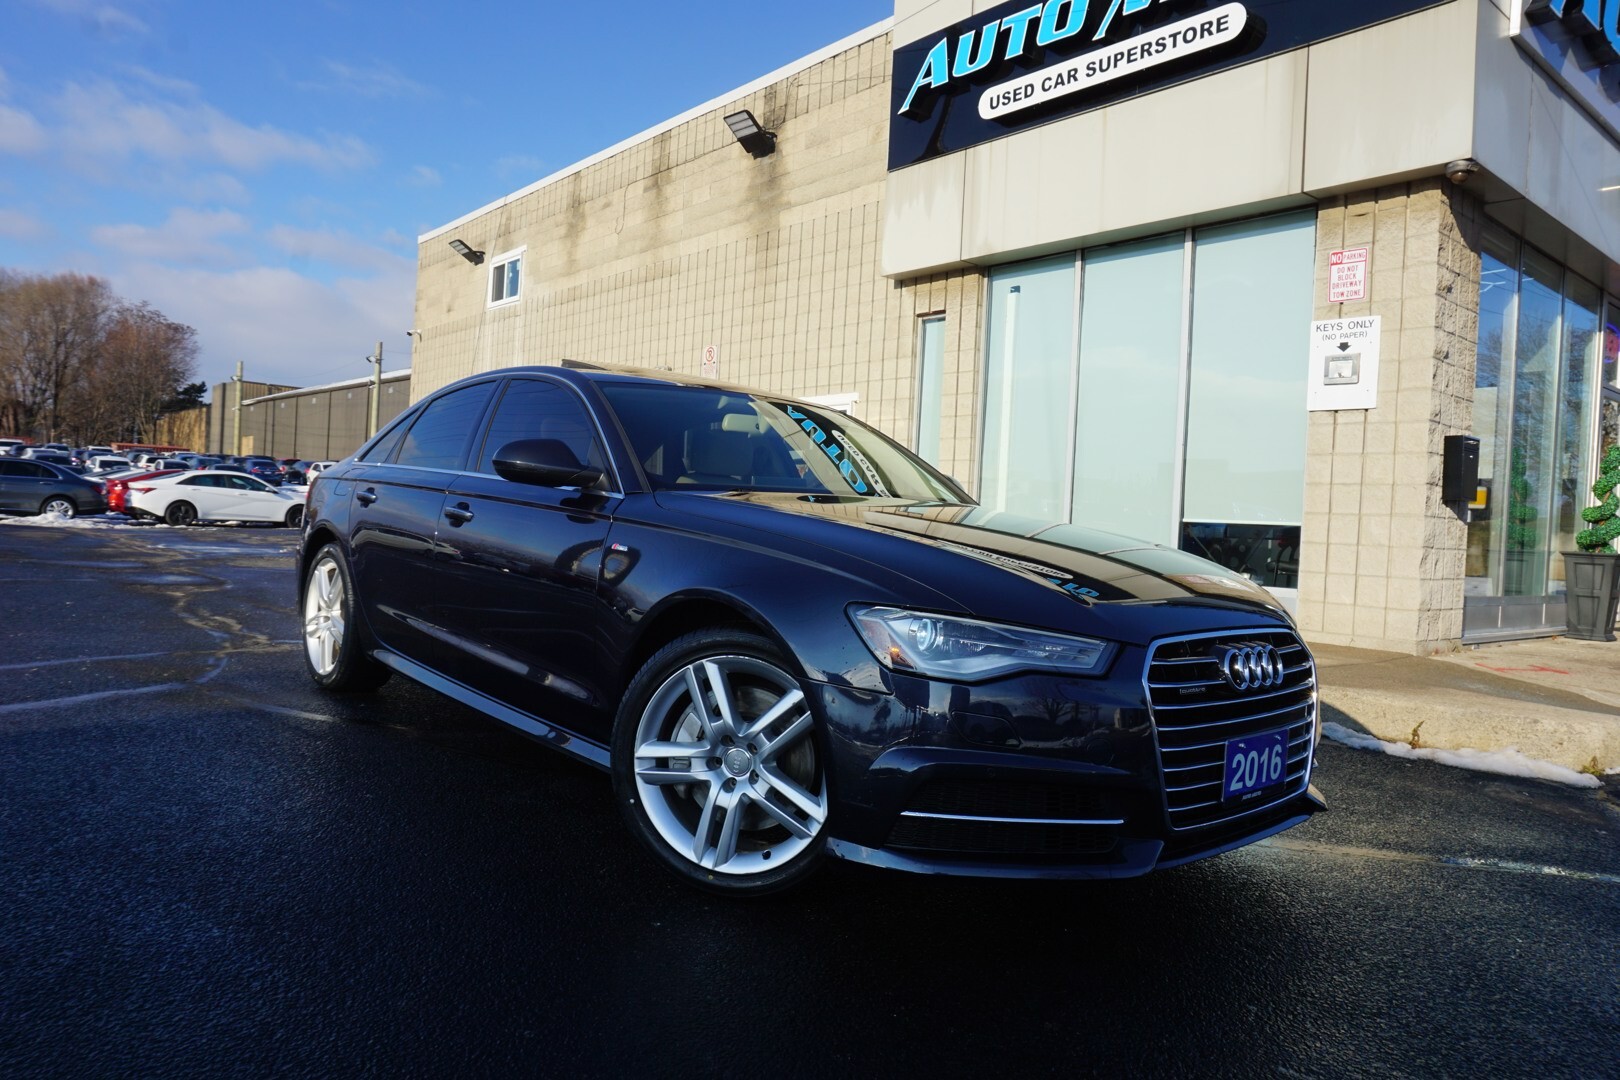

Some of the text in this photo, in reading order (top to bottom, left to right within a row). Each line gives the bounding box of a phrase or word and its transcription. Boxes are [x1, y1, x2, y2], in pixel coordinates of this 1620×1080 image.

[897, 0, 1090, 114] AUTO
[989, 83, 1035, 110] USED
[1041, 68, 1079, 92] CAR
[1085, 14, 1230, 78] SUPERSTORE
[1331, 251, 1366, 264] NO PARKING
[1337, 266, 1346, 274] DO
[1337, 273, 1357, 281] BLOCK
[1332, 280, 1362, 289] DRIVEWAY
[1346, 289, 1361, 297] ZONE
[1315, 319, 1375, 333] KEYS ONLY
[1322, 330, 1368, 341] (NO PAPER)
[1230, 744, 1282, 791] 2016
